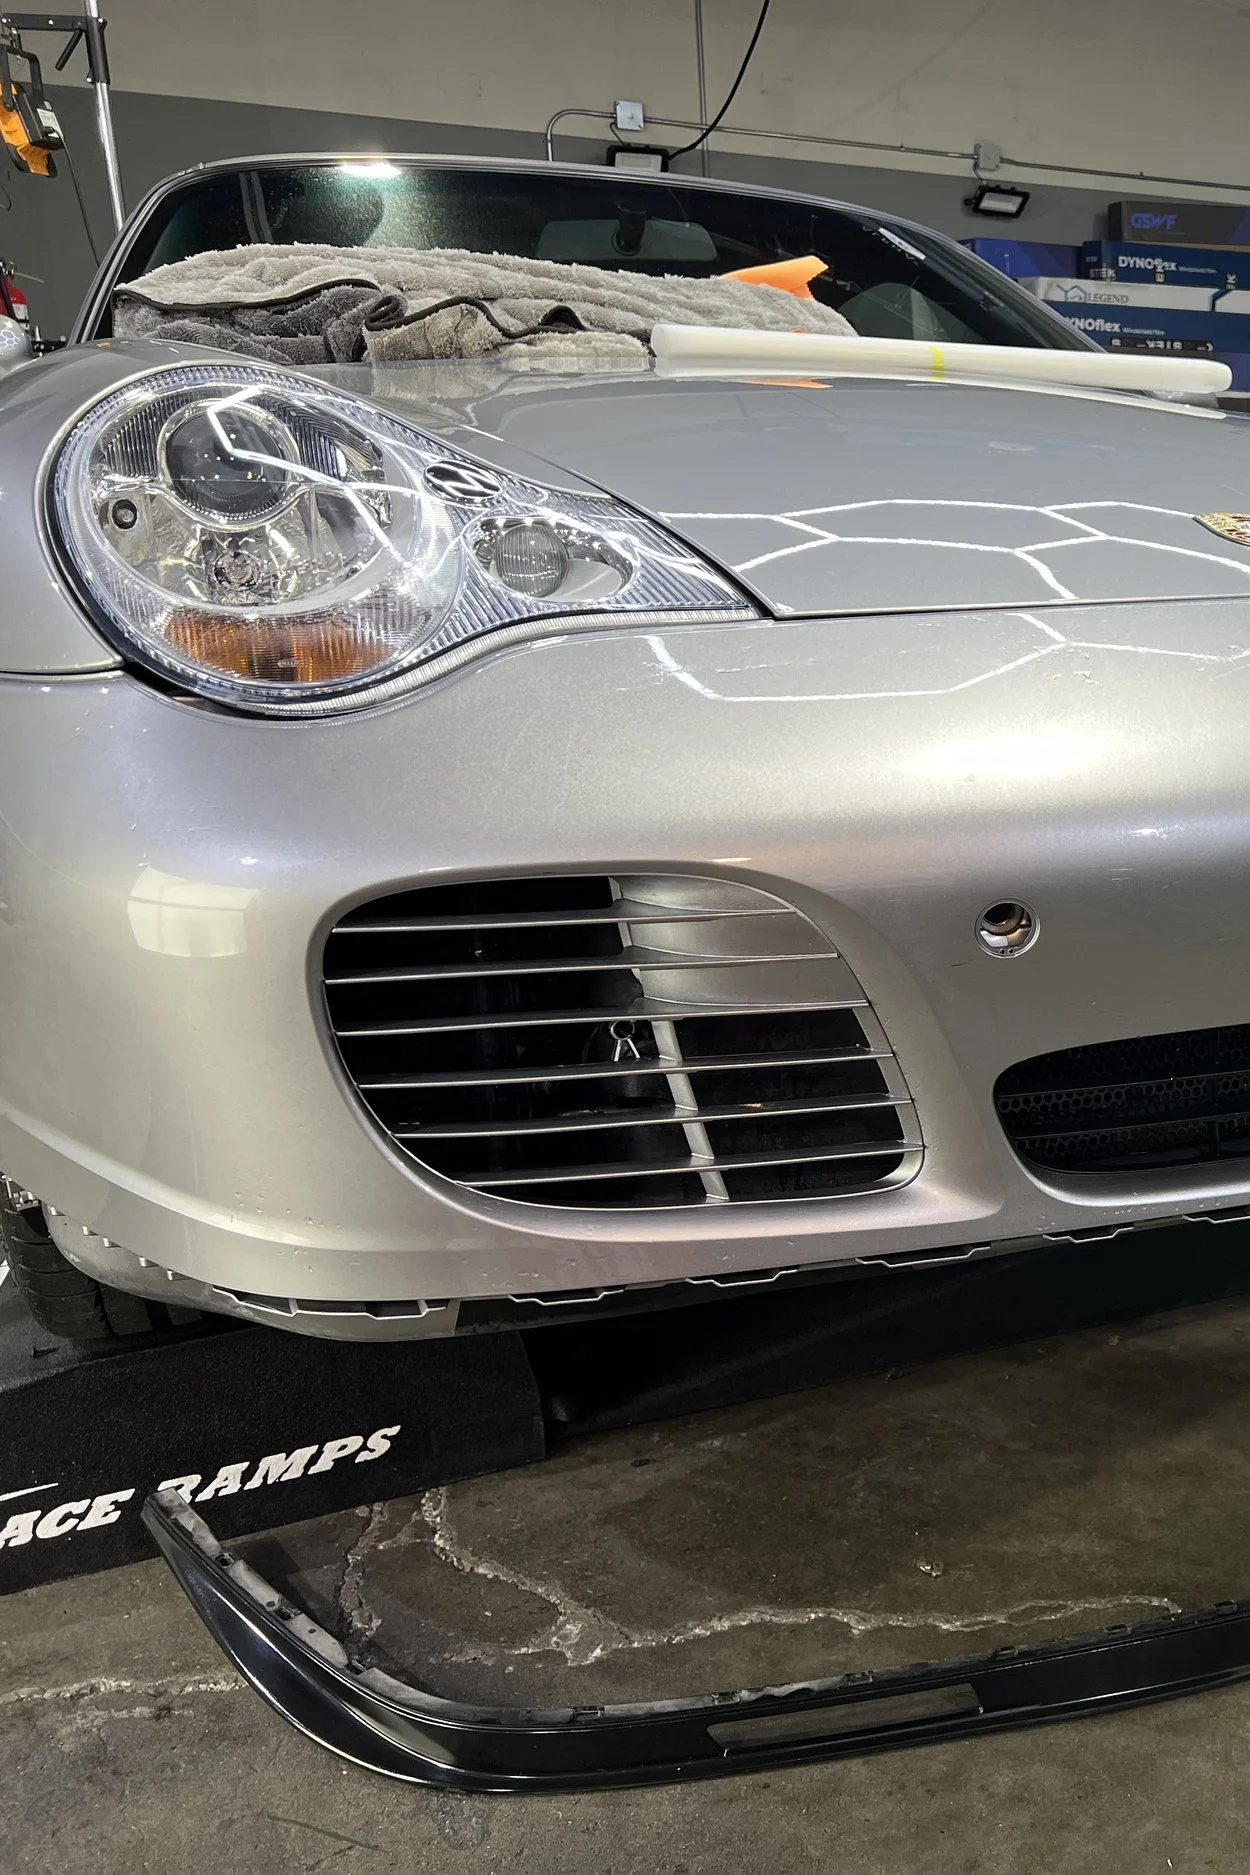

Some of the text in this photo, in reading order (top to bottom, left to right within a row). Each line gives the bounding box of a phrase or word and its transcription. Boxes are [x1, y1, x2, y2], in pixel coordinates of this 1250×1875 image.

[1088, 292, 1130, 305] LEGEND
[1064, 317, 1121, 333] YNOflex
[0, 1488, 136, 1551] ACE
